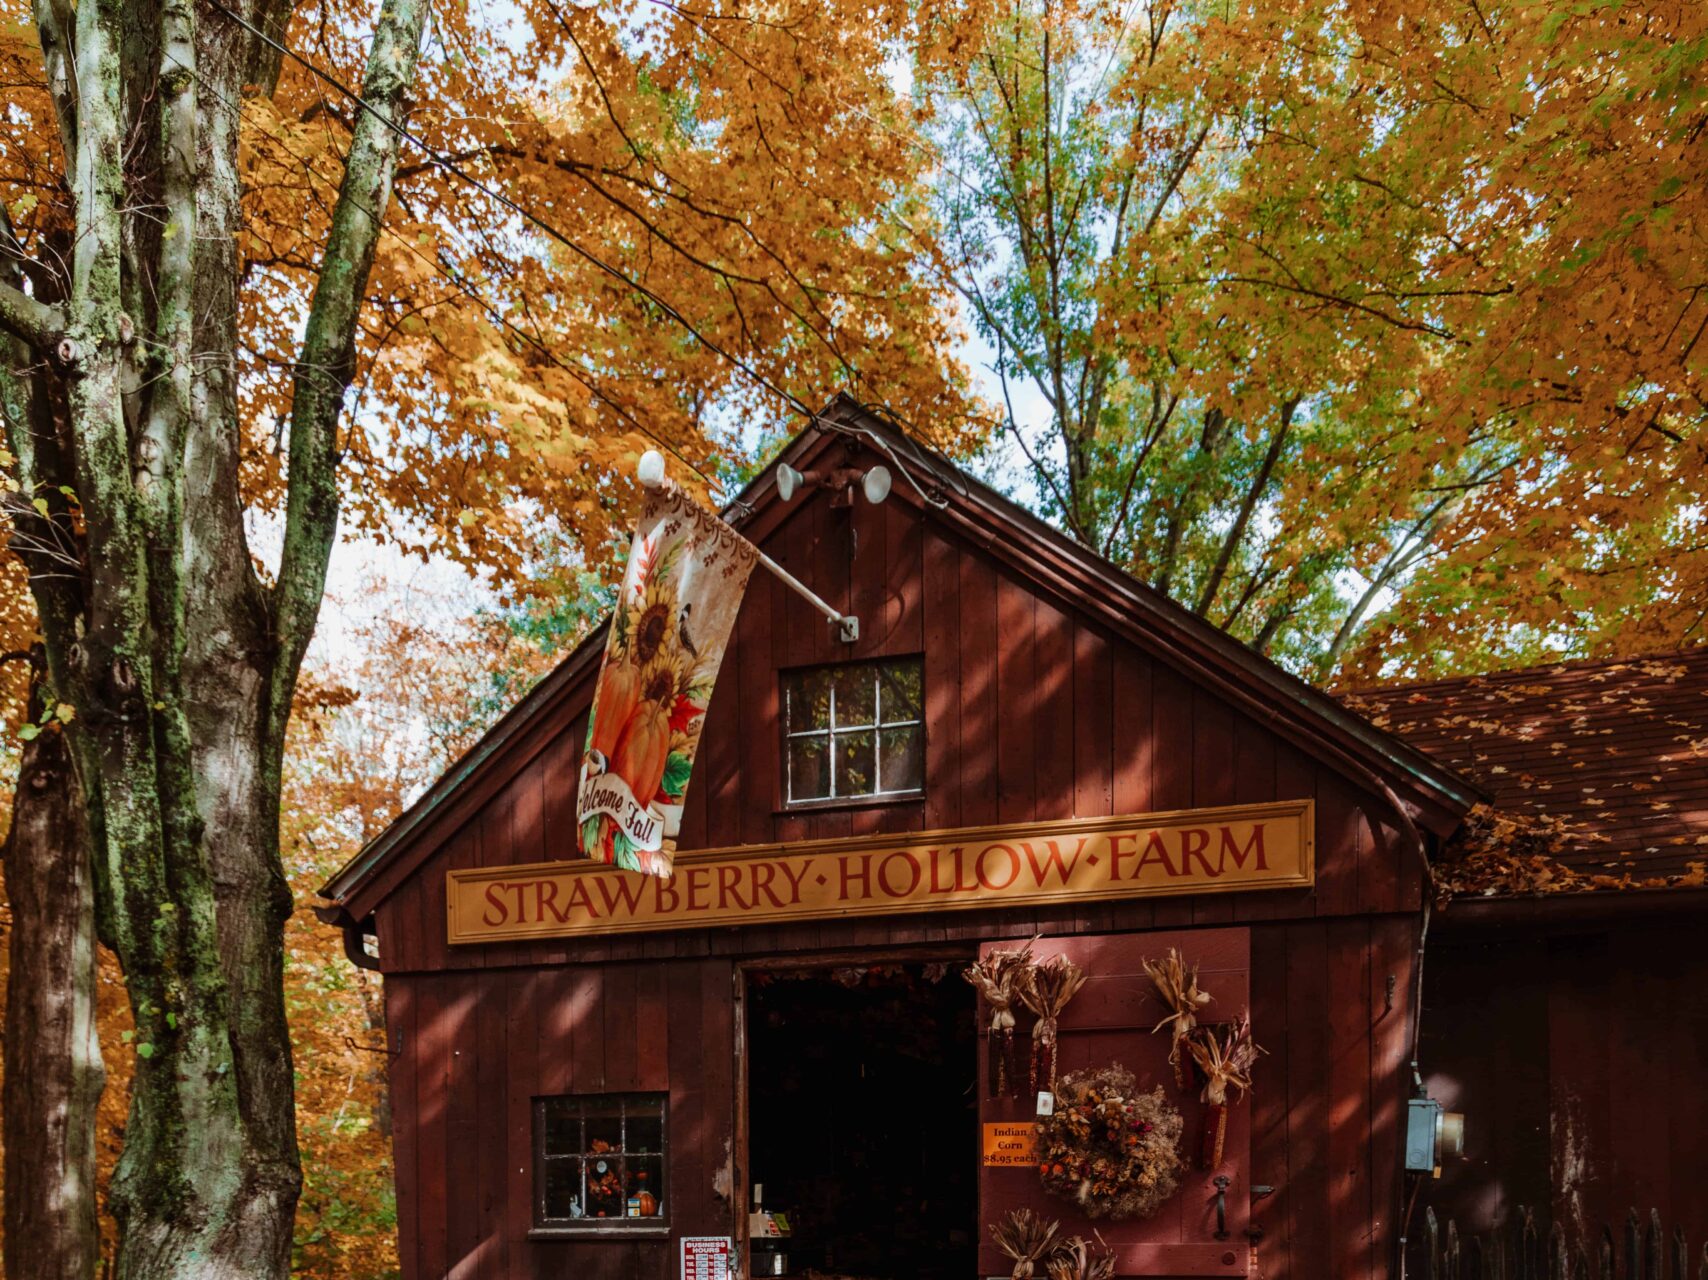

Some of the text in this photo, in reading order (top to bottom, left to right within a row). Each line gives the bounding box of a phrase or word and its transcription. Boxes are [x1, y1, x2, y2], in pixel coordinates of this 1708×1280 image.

[625, 801, 655, 843] Fall
[482, 823, 1271, 927] STRAWBERRY HOLLOW FARM
[994, 1128, 1027, 1136] Indian
[998, 1141, 1022, 1149] Corn
[984, 1153, 1037, 1164] $8.95 each
